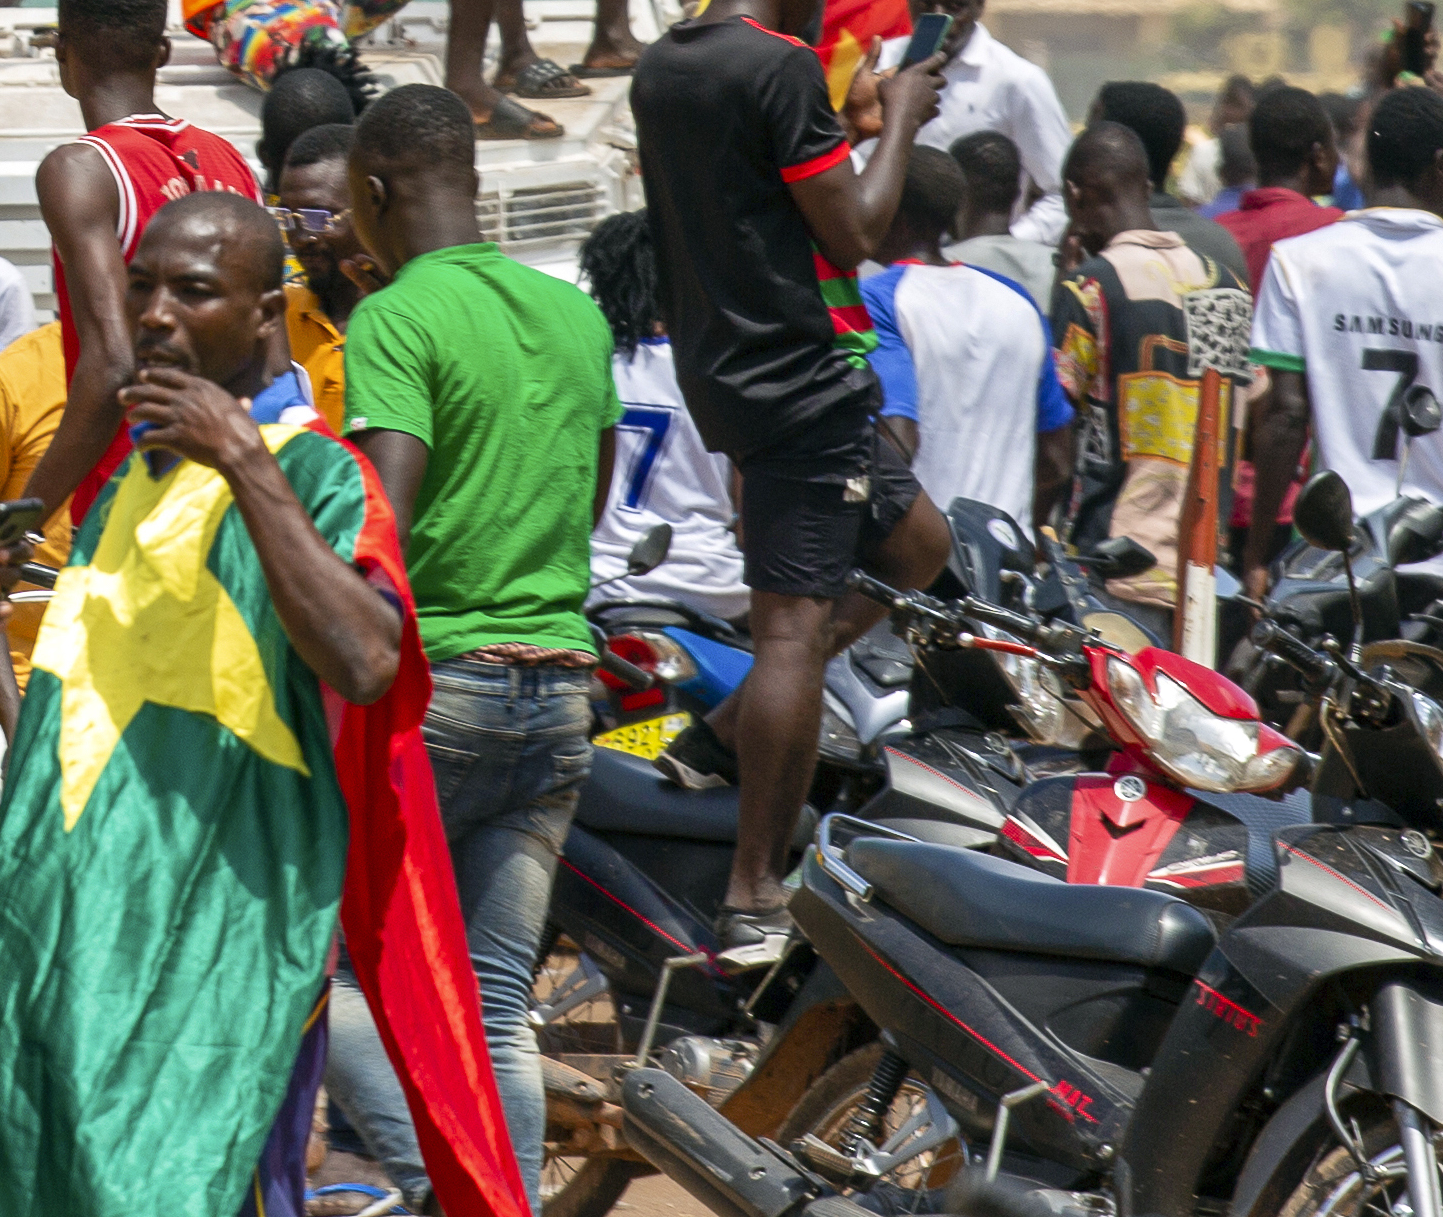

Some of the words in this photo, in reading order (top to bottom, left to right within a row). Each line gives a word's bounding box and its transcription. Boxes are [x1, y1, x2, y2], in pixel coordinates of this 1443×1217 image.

[1333, 312, 1443, 344] SAMSUNG
[615, 401, 680, 515] 7
[1361, 347, 1419, 461] 7
